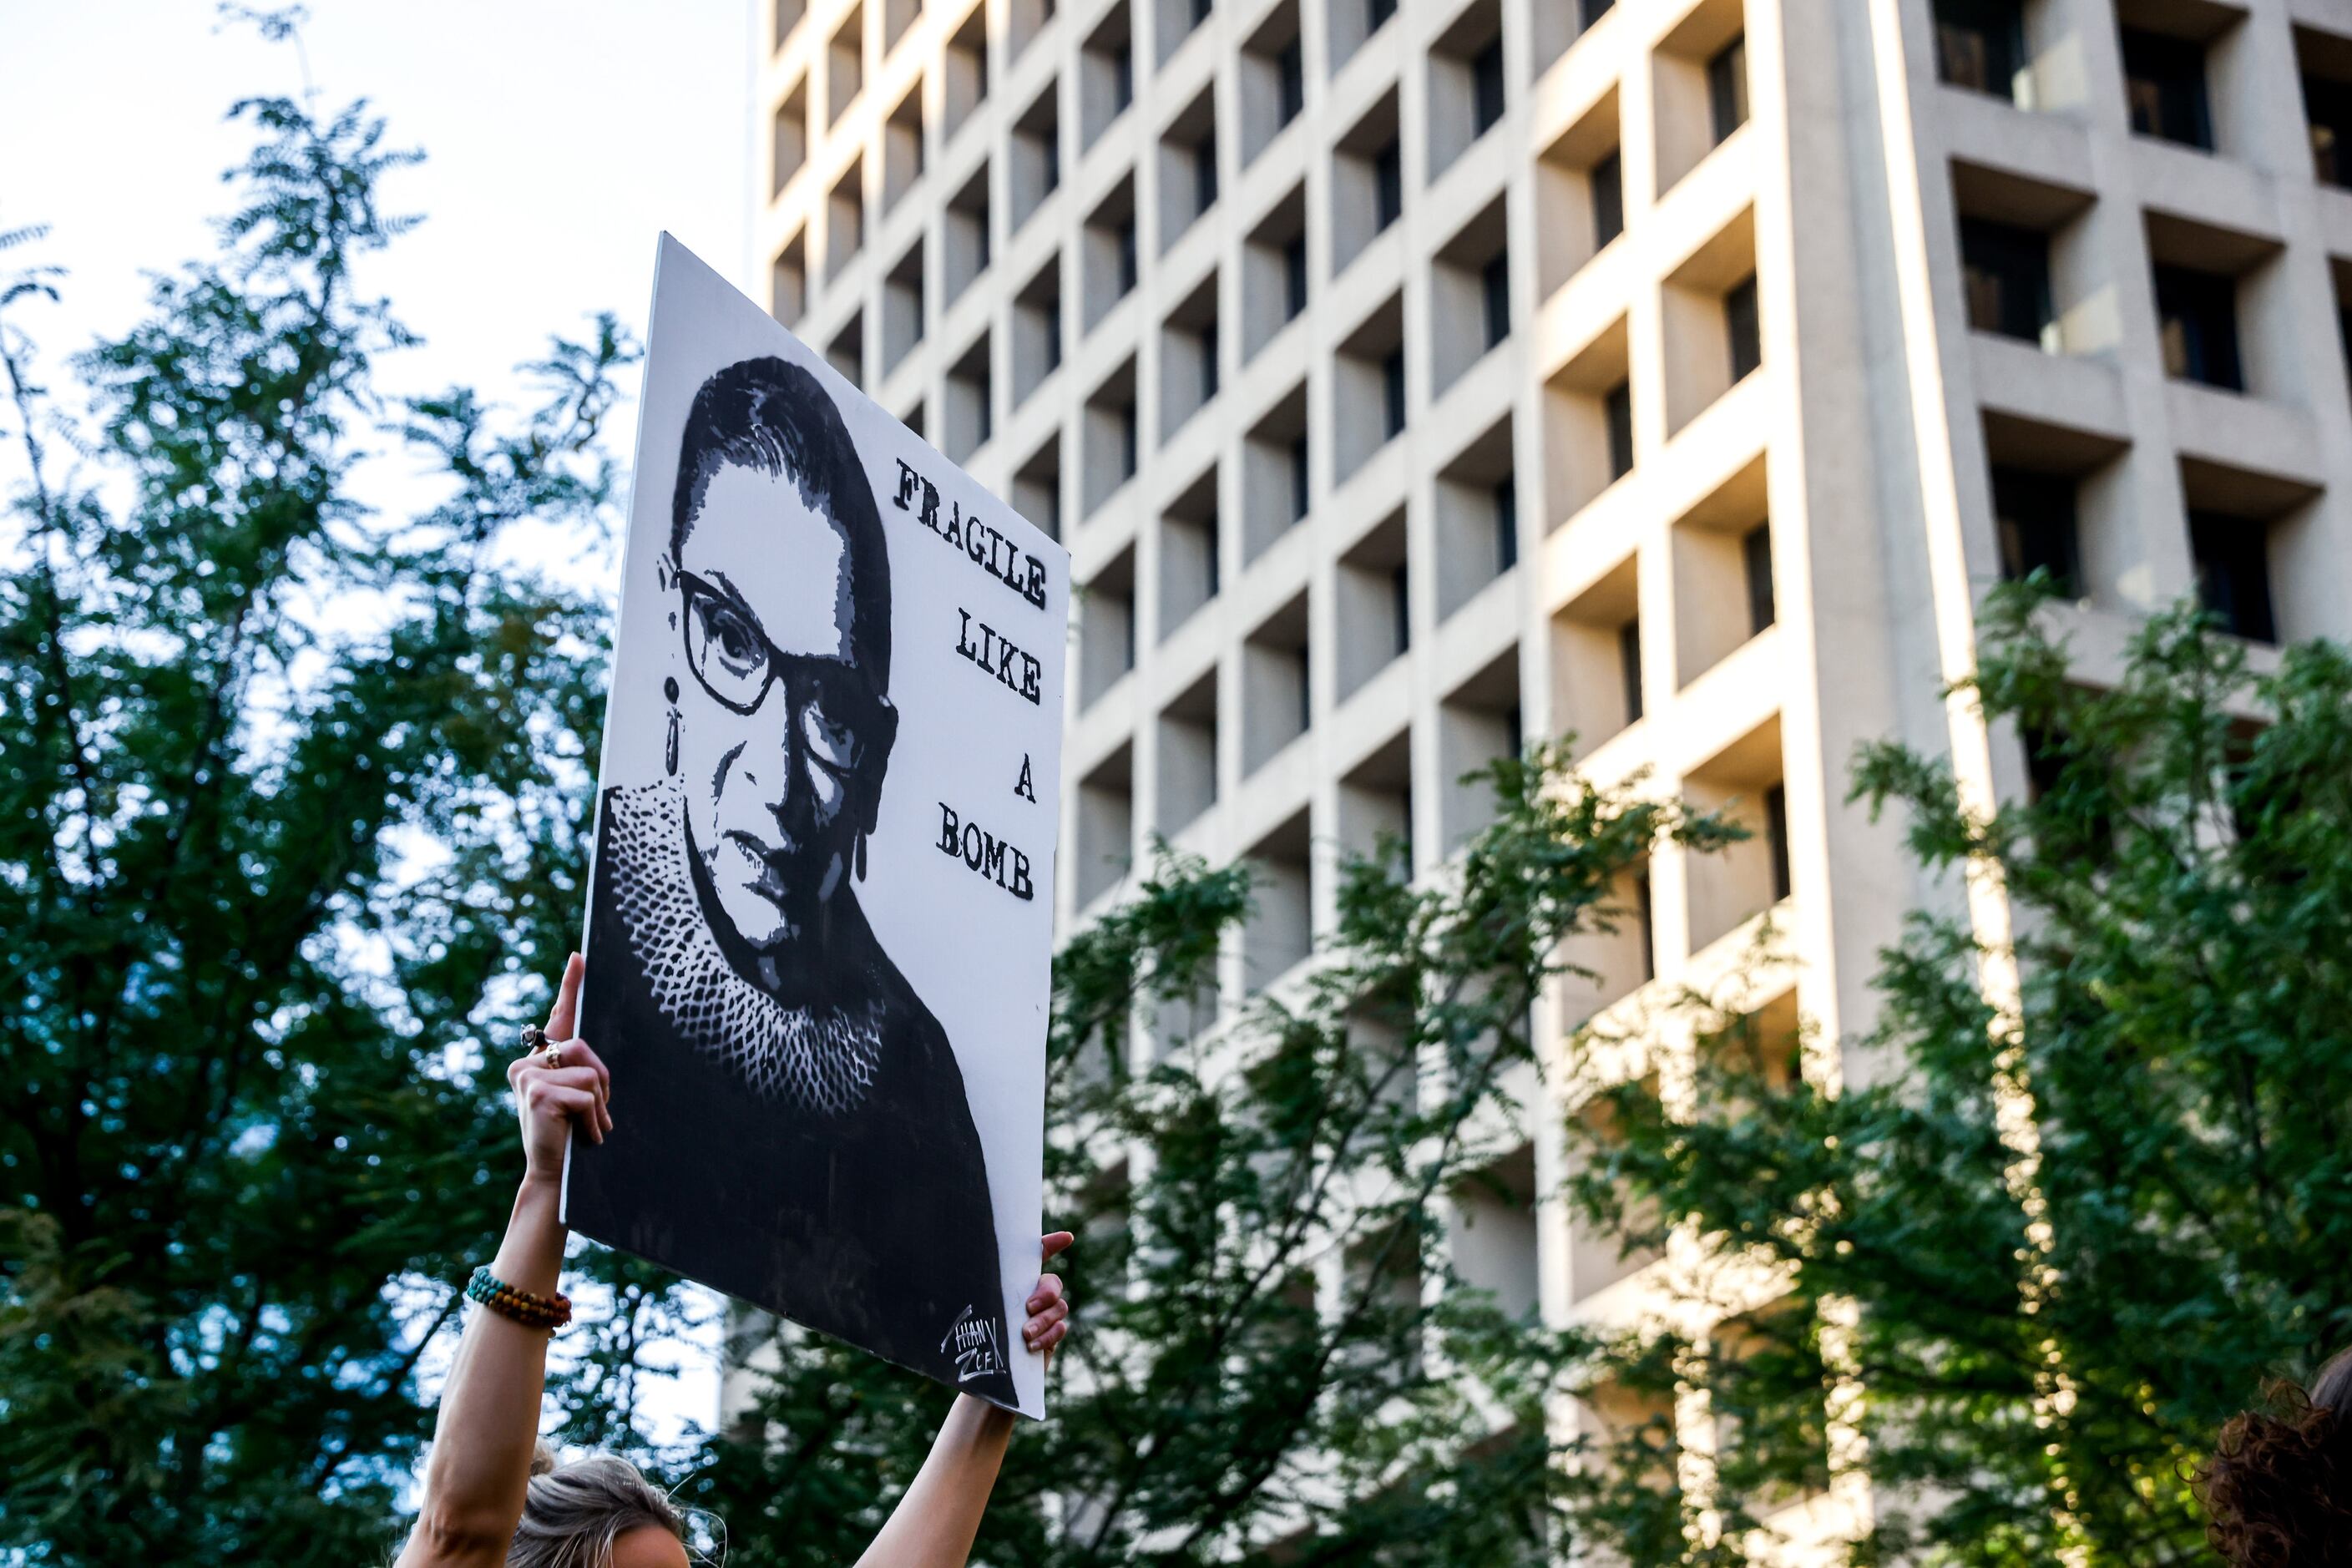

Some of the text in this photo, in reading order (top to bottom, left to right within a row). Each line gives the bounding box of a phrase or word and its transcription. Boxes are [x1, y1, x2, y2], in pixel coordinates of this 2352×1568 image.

[893, 457, 1046, 610] FRAGILE
[955, 607, 1041, 706] LIKE
[1014, 752, 1036, 804] A
[936, 802, 1034, 902] BOMB
